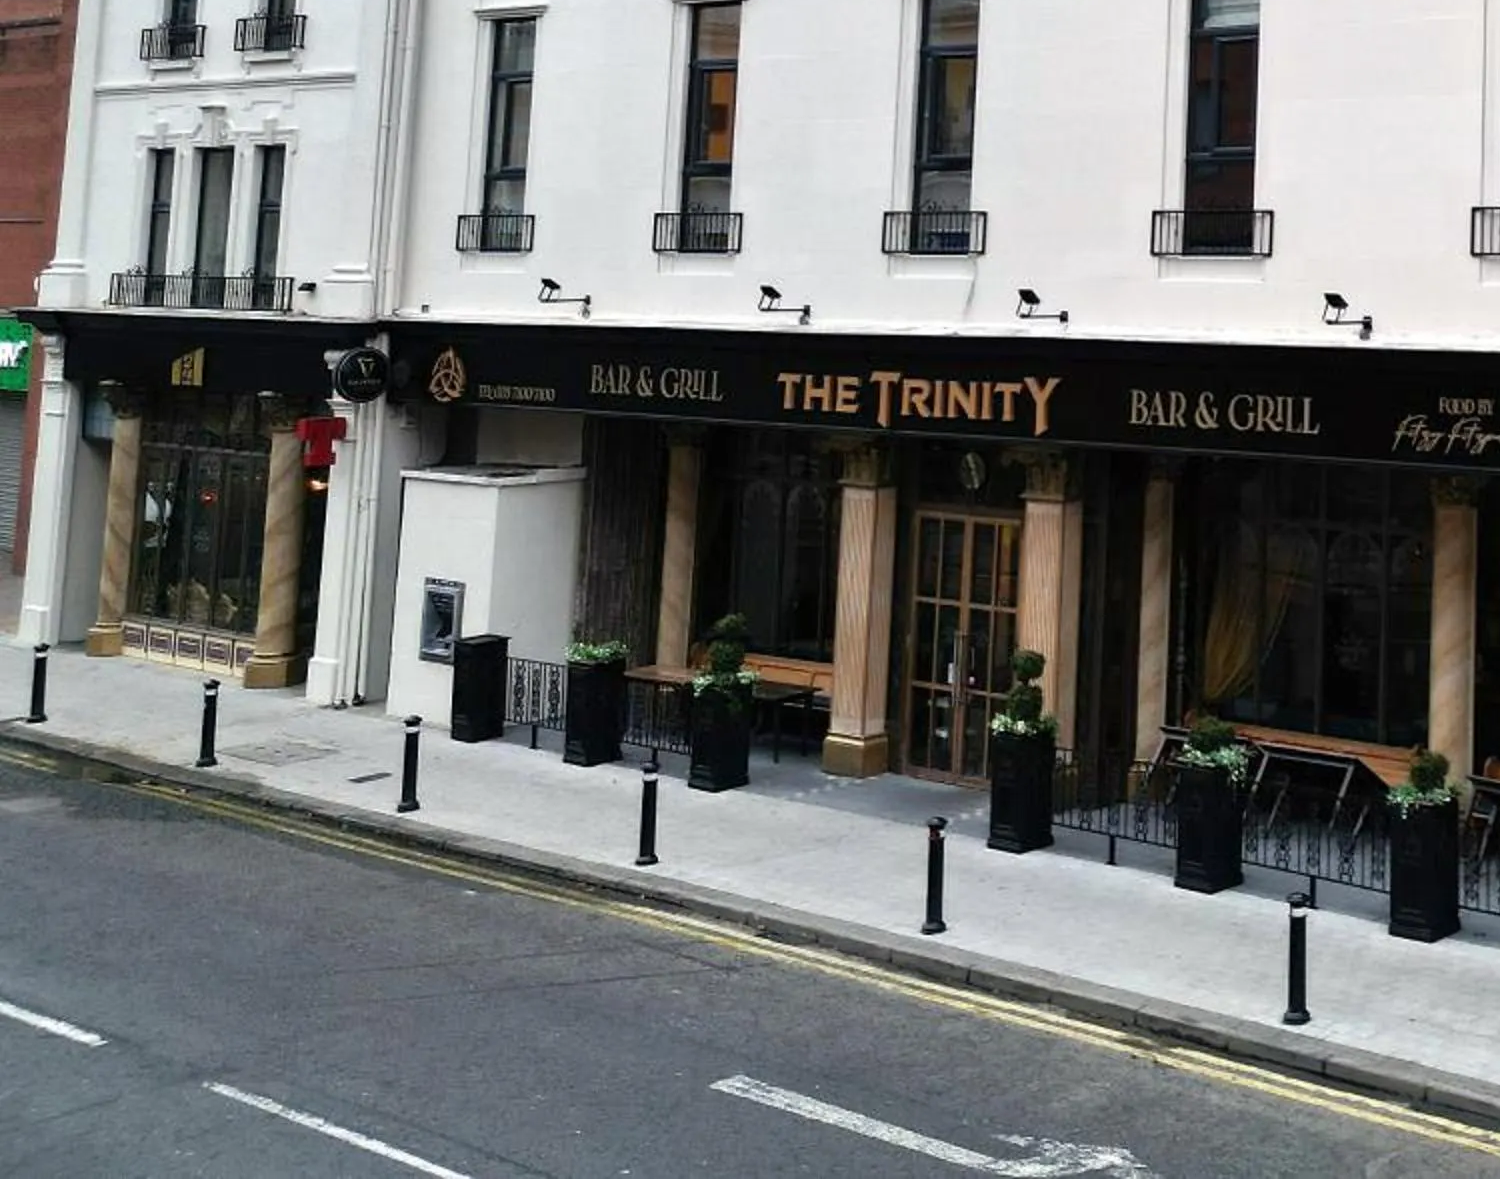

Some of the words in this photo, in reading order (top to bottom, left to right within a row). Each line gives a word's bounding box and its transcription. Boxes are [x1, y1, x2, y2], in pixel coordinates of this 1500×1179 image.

[591, 362, 631, 395] BAR
[637, 366, 654, 397] &
[661, 368, 723, 401] GRILL
[777, 372, 863, 413] THE
[870, 371, 1062, 437] TRINITY
[1129, 389, 1187, 427] BAR
[1195, 391, 1219, 429] &
[1228, 394, 1320, 435] GRILL
[1439, 396, 1475, 415] FOOD
